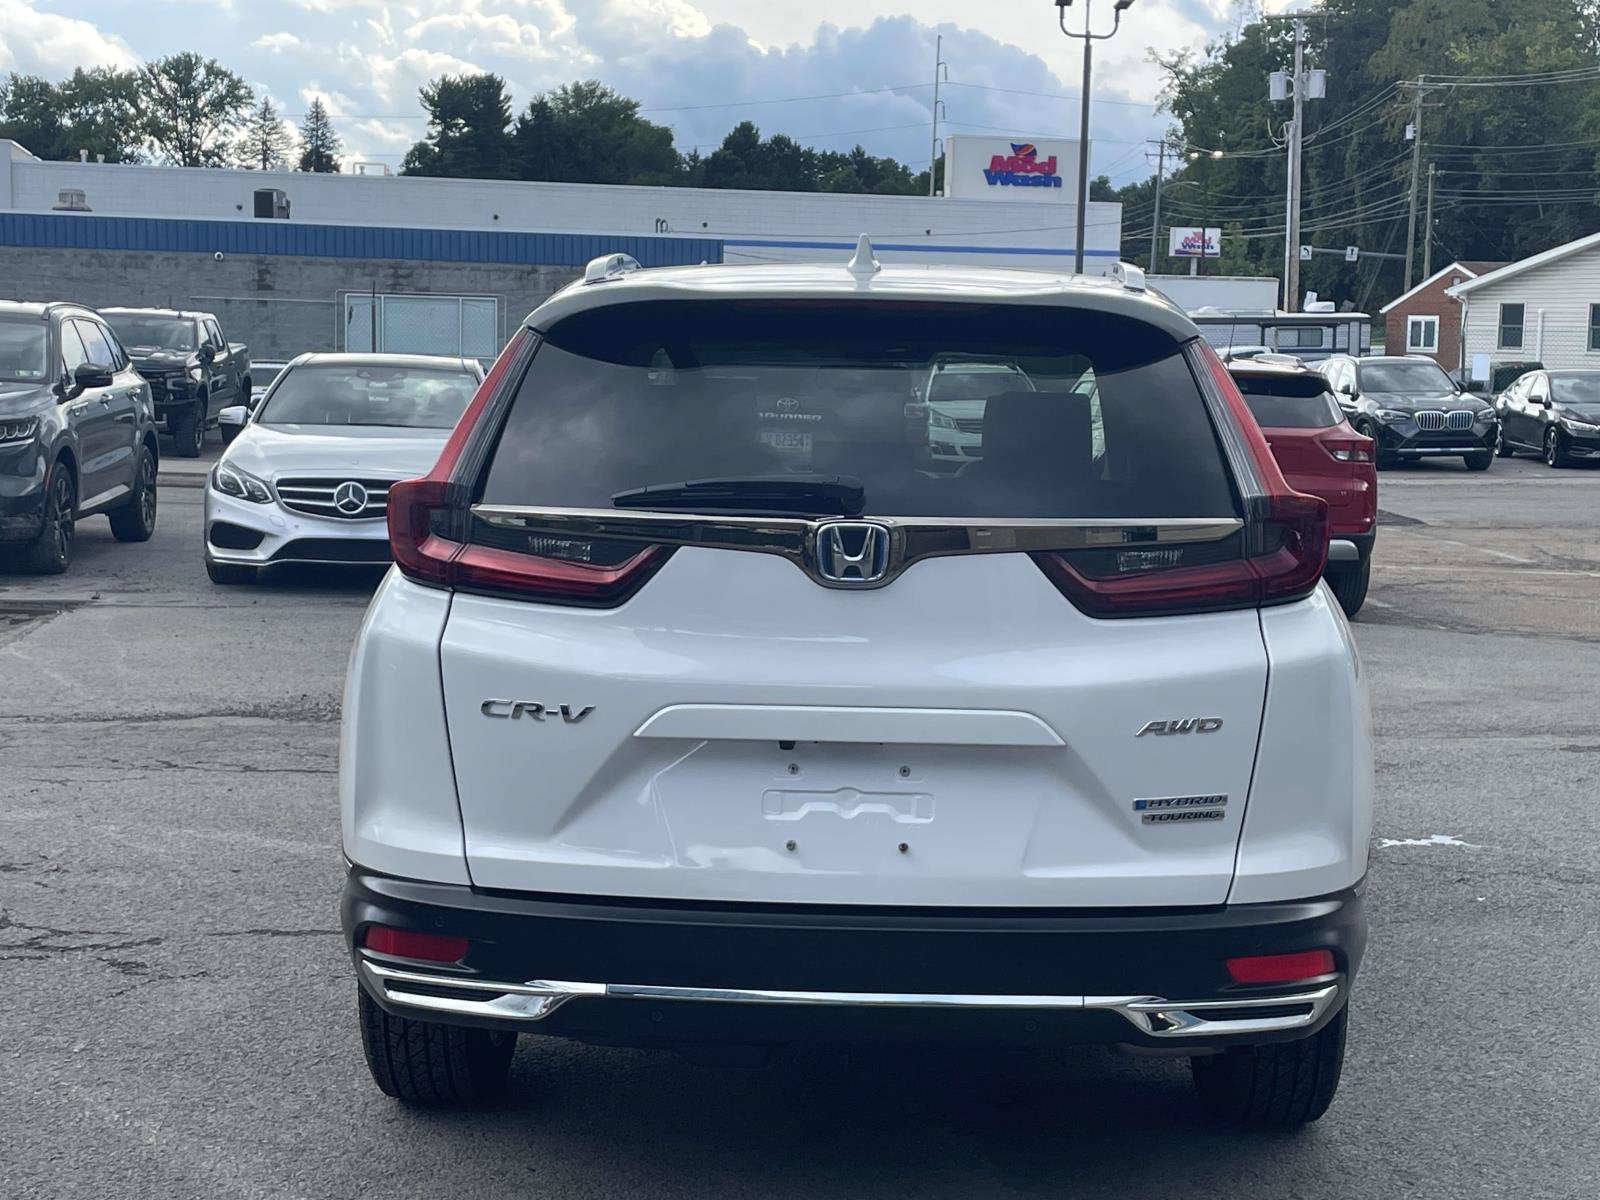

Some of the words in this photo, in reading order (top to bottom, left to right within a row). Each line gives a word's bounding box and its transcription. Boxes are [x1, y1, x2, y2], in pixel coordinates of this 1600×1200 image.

[983, 169, 1062, 188] Wash
[480, 698, 597, 724] CR-V
[1135, 716, 1224, 737] AWD
[1148, 795, 1223, 808] HYBRID
[1149, 810, 1221, 822] TOURING
